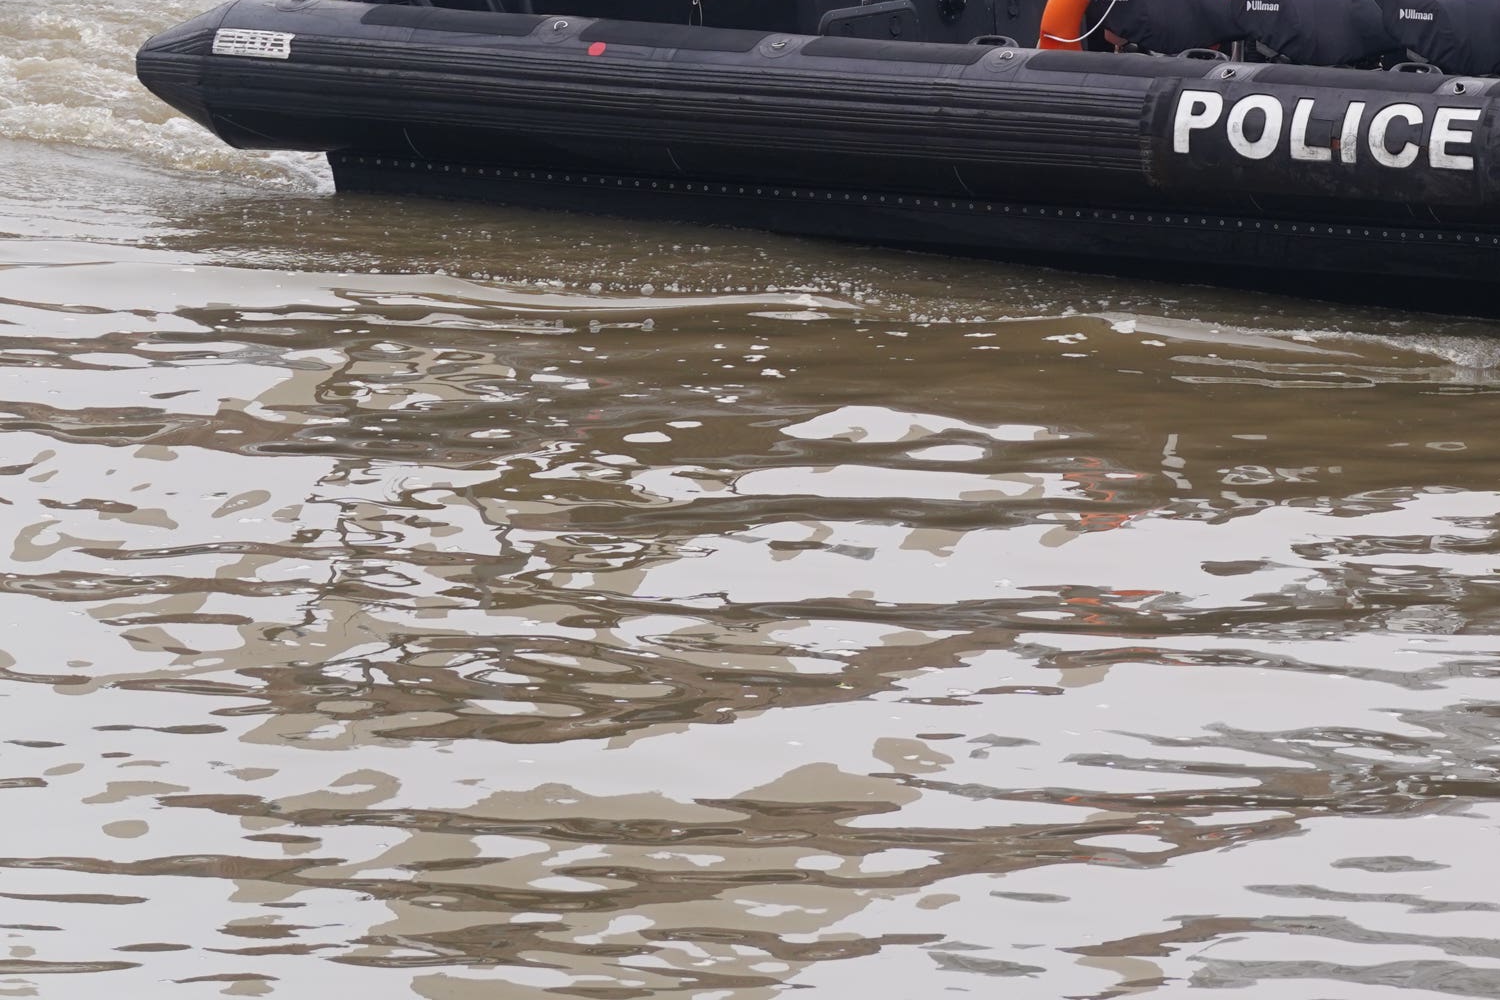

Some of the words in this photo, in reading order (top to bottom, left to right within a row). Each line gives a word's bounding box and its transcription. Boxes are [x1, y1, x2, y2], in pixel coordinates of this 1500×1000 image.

[1251, 0, 1280, 12] Ullman
[1405, 8, 1433, 20] Ullman
[1173, 90, 1480, 171] POLICE
